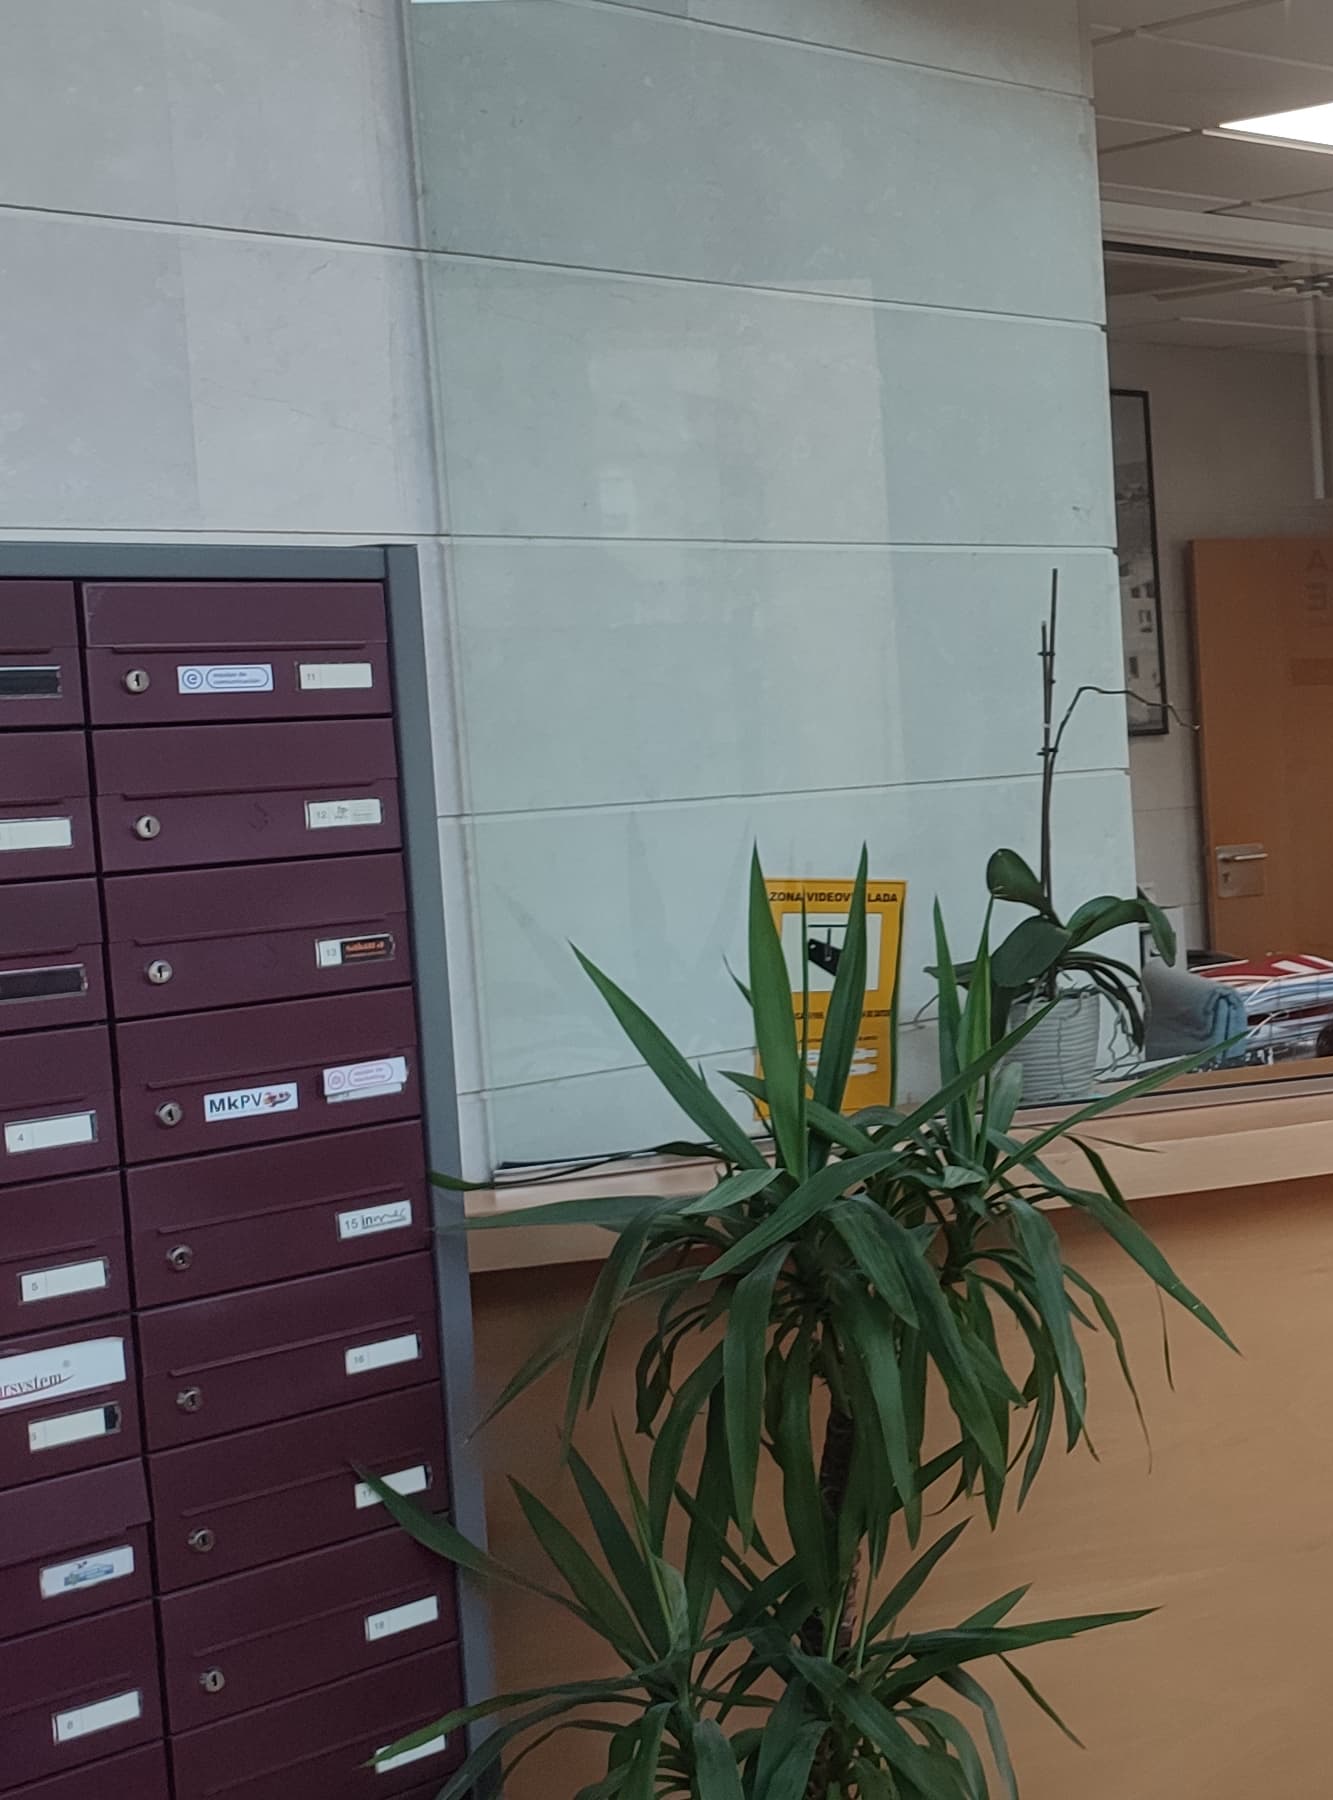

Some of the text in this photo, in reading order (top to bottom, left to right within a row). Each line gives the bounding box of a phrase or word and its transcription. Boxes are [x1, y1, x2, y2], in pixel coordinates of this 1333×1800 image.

[769, 892, 897, 903] ZONA VIDEOVLADA
[209, 1092, 262, 1114] MkPV
[345, 1217, 359, 1231] 15
